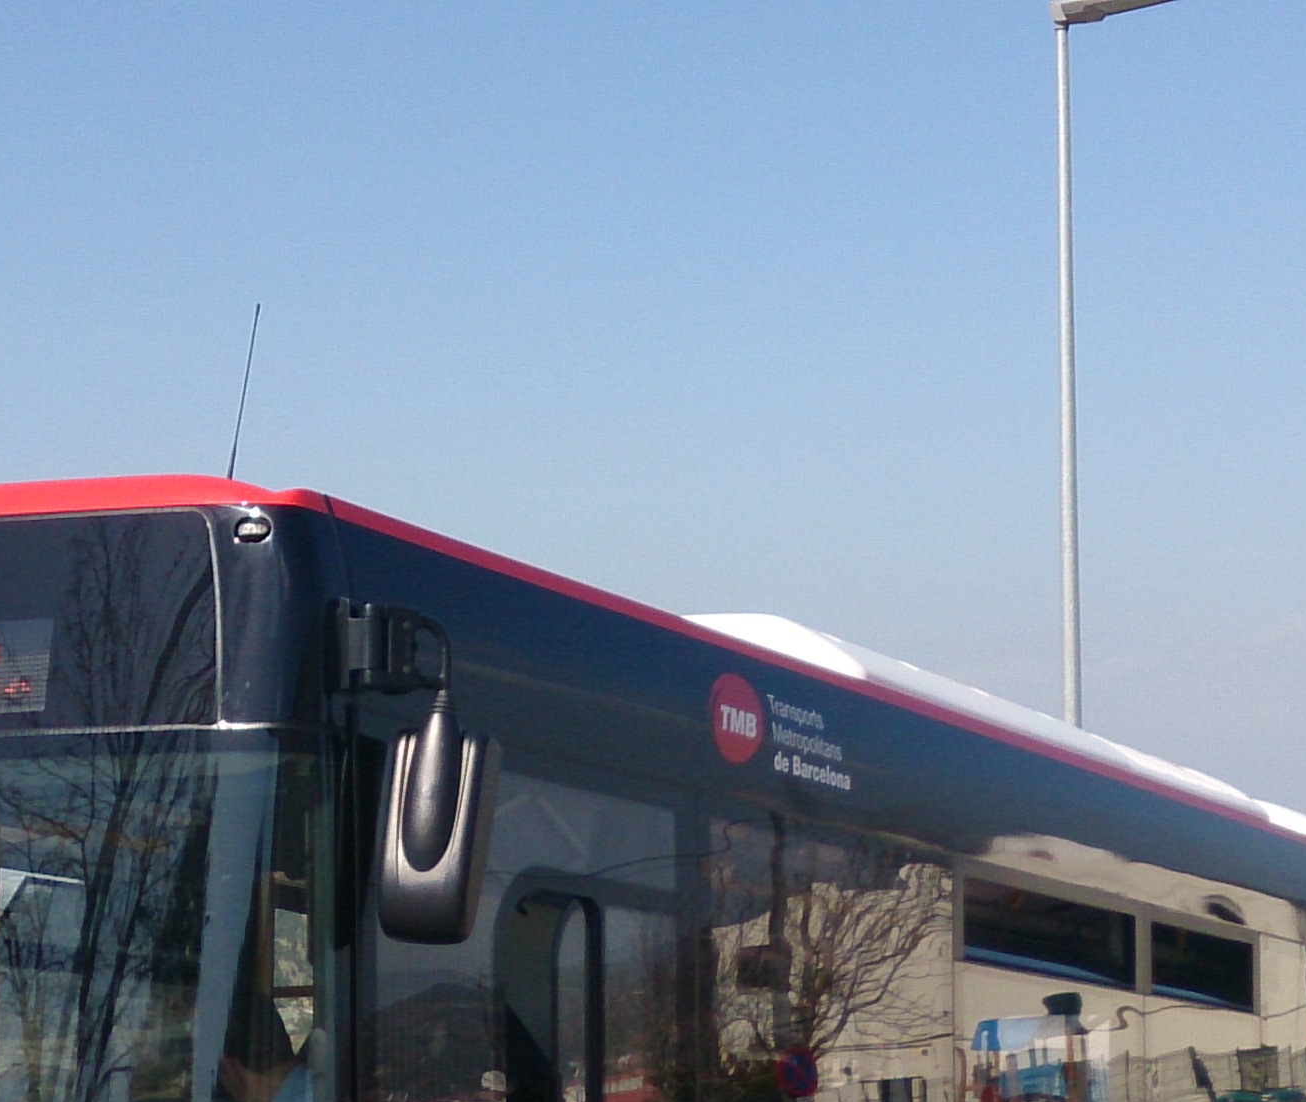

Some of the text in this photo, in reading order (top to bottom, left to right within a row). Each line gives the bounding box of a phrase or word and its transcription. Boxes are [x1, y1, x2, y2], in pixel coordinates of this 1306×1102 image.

[720, 704, 758, 738] TMB
[766, 693, 825, 731] Transports
[772, 721, 843, 762] Metropolitans
[774, 750, 851, 791] de Barcelona
